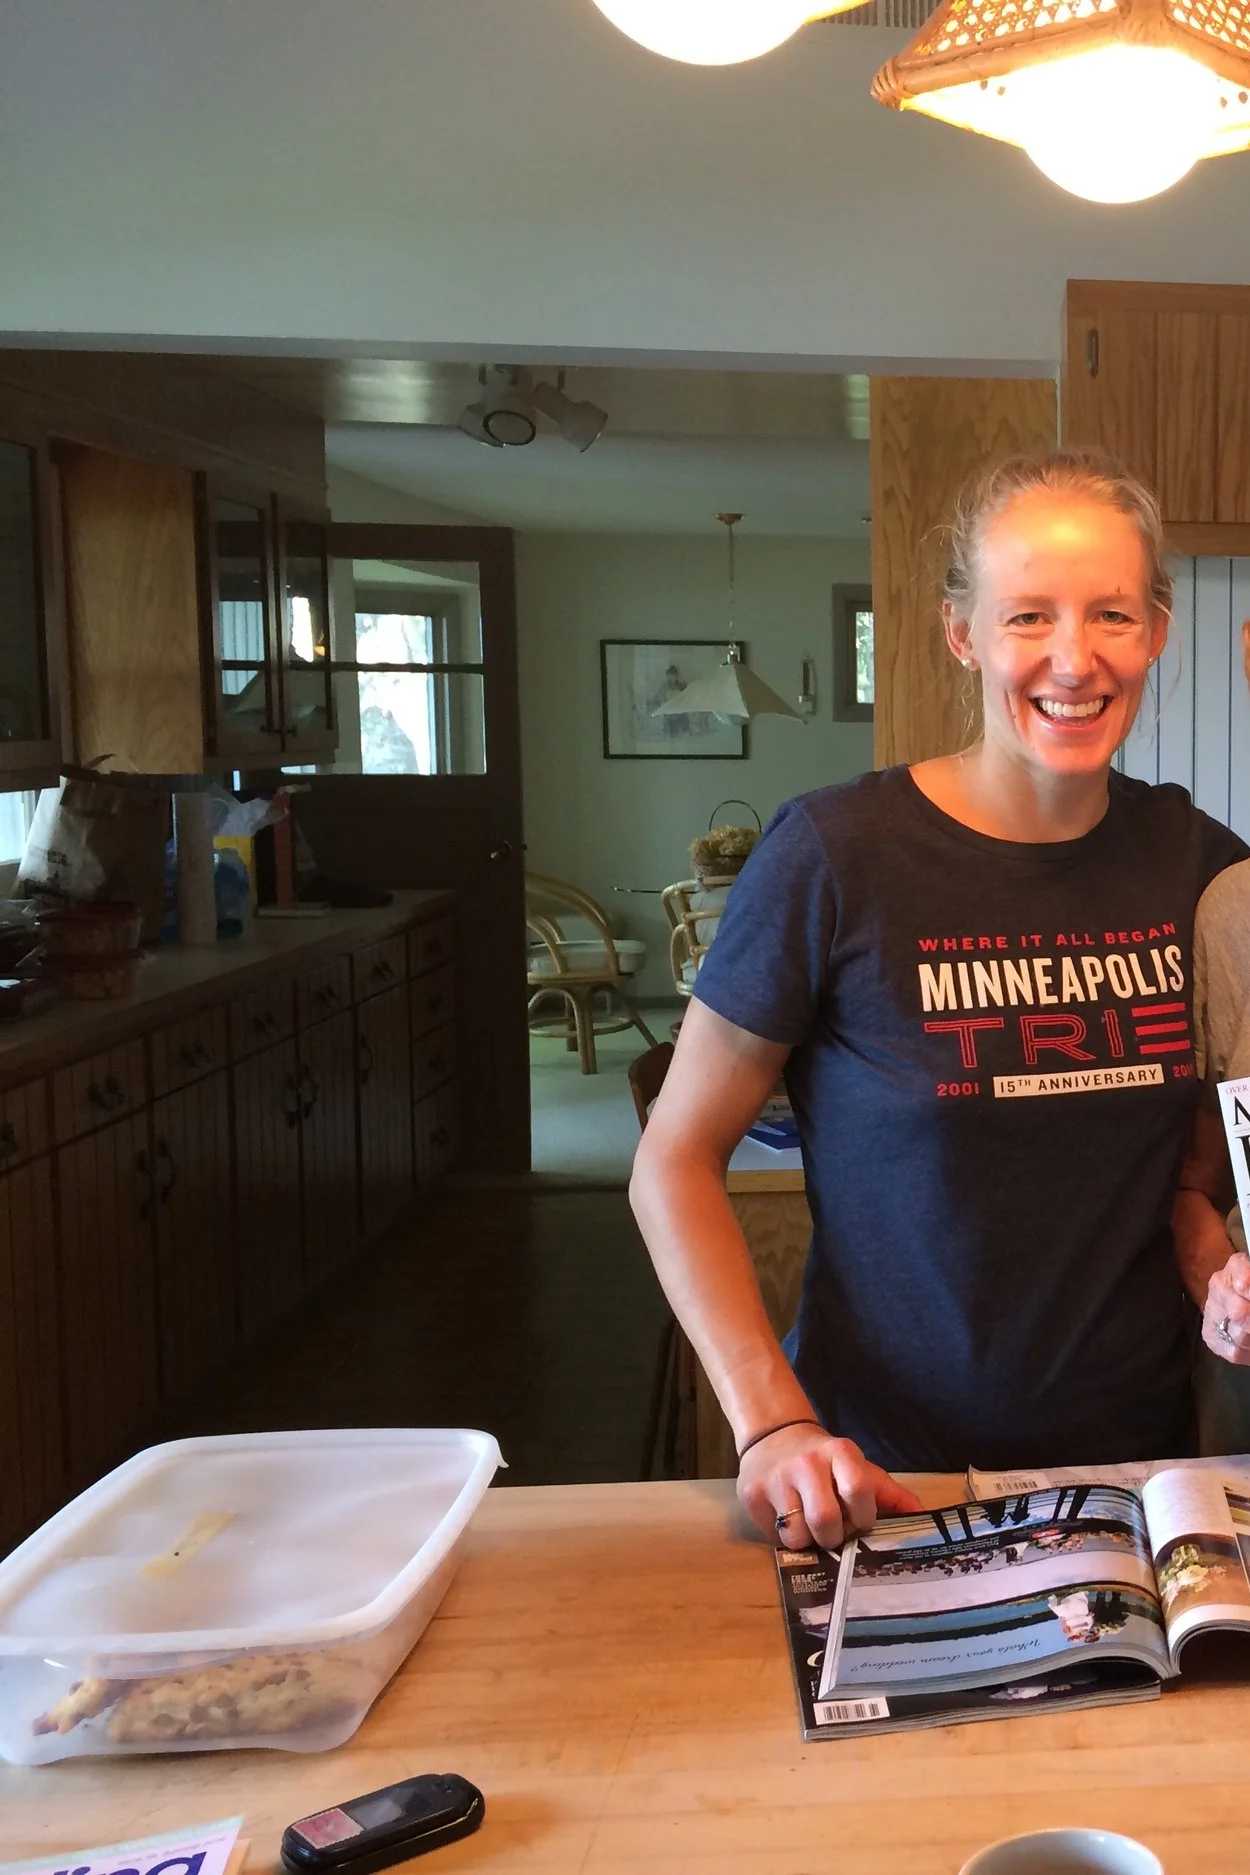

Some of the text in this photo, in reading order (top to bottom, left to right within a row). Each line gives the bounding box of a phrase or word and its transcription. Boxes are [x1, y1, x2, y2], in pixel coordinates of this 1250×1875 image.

[918, 922, 1176, 951] WHERE IT ALL BEGAN
[918, 944, 1185, 1012] MINNEAPOLIS
[1000, 1069, 1158, 1094] 15TH ANNIVERSARY
[936, 1082, 980, 1097] 2001
[1225, 1084, 1248, 1095] OVER
[920, 1653, 961, 1664] dream
[965, 1648, 993, 1658] your
[851, 1658, 917, 1673] wedding?
